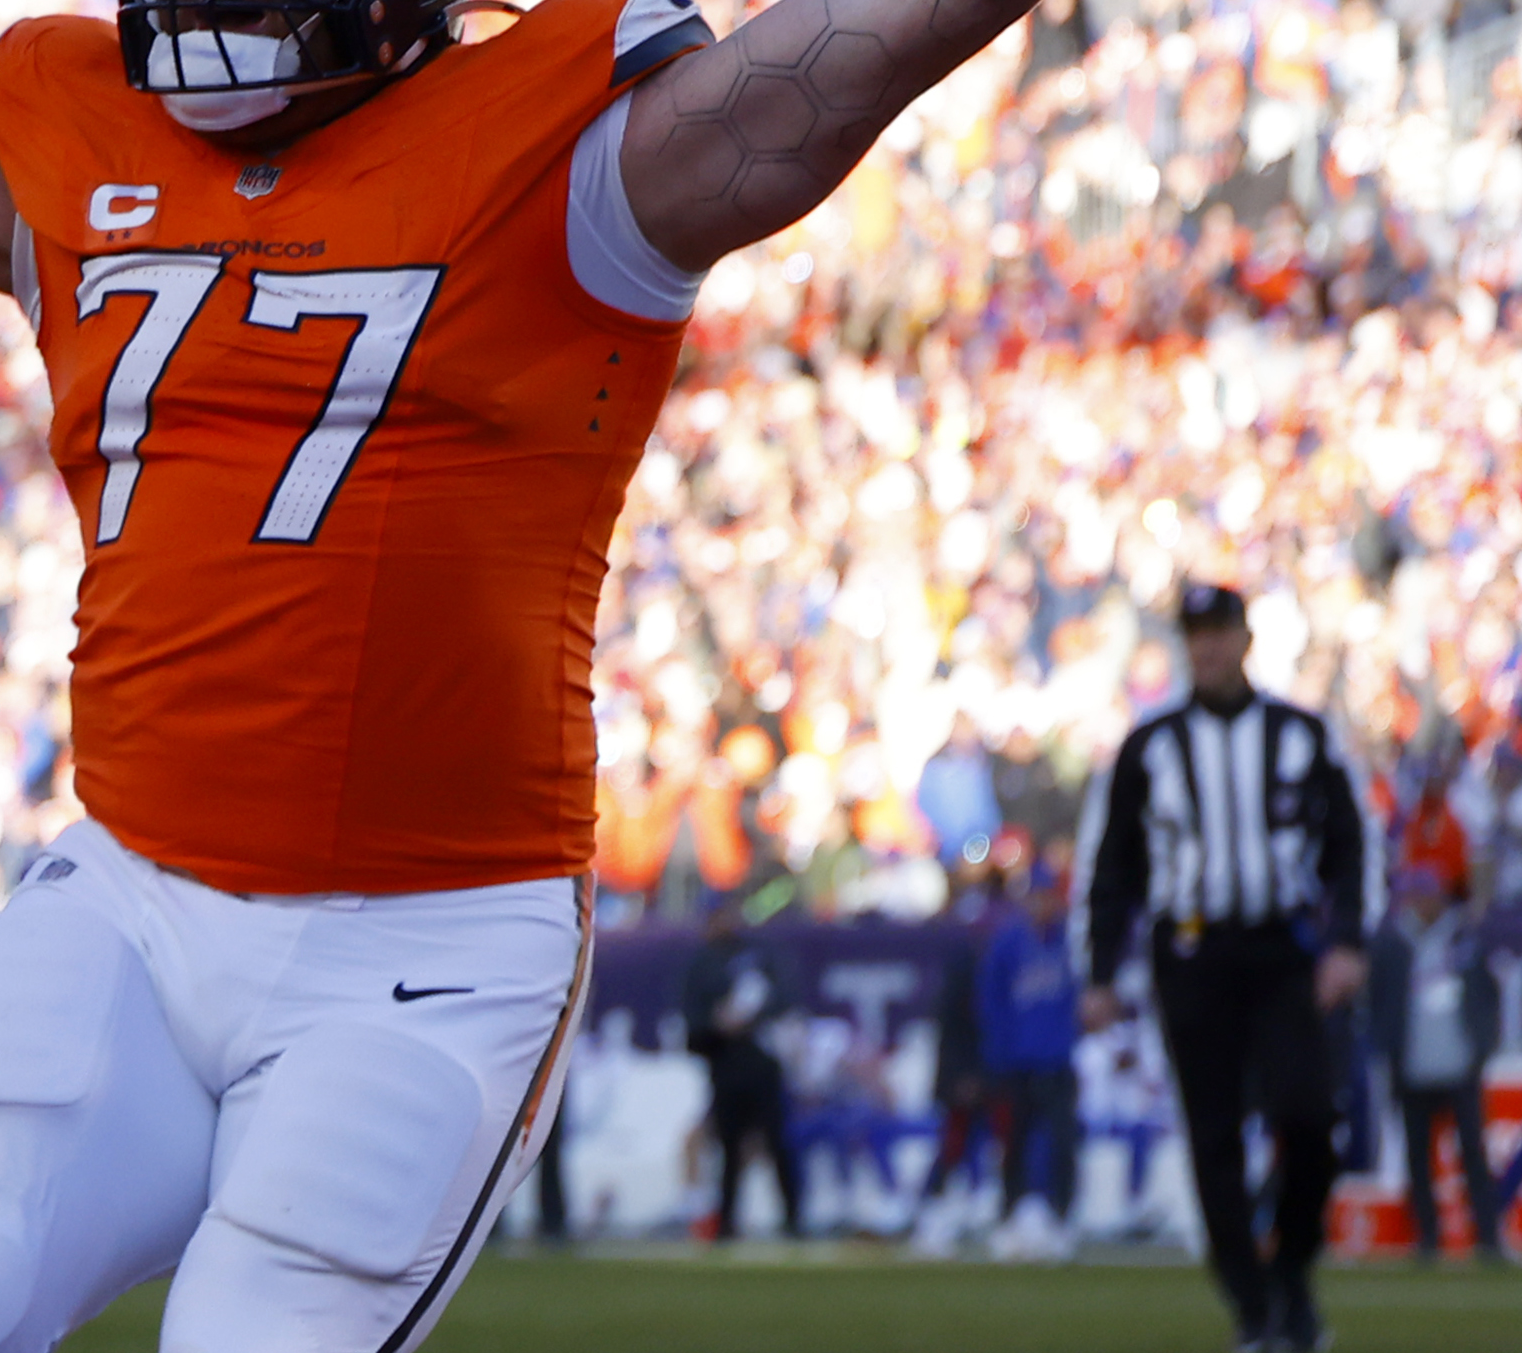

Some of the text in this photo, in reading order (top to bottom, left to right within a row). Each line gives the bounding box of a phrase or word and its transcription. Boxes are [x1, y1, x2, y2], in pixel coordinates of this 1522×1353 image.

[89, 183, 160, 231] C
[181, 240, 326, 258] RONCOS
[75, 249, 448, 548] 77
